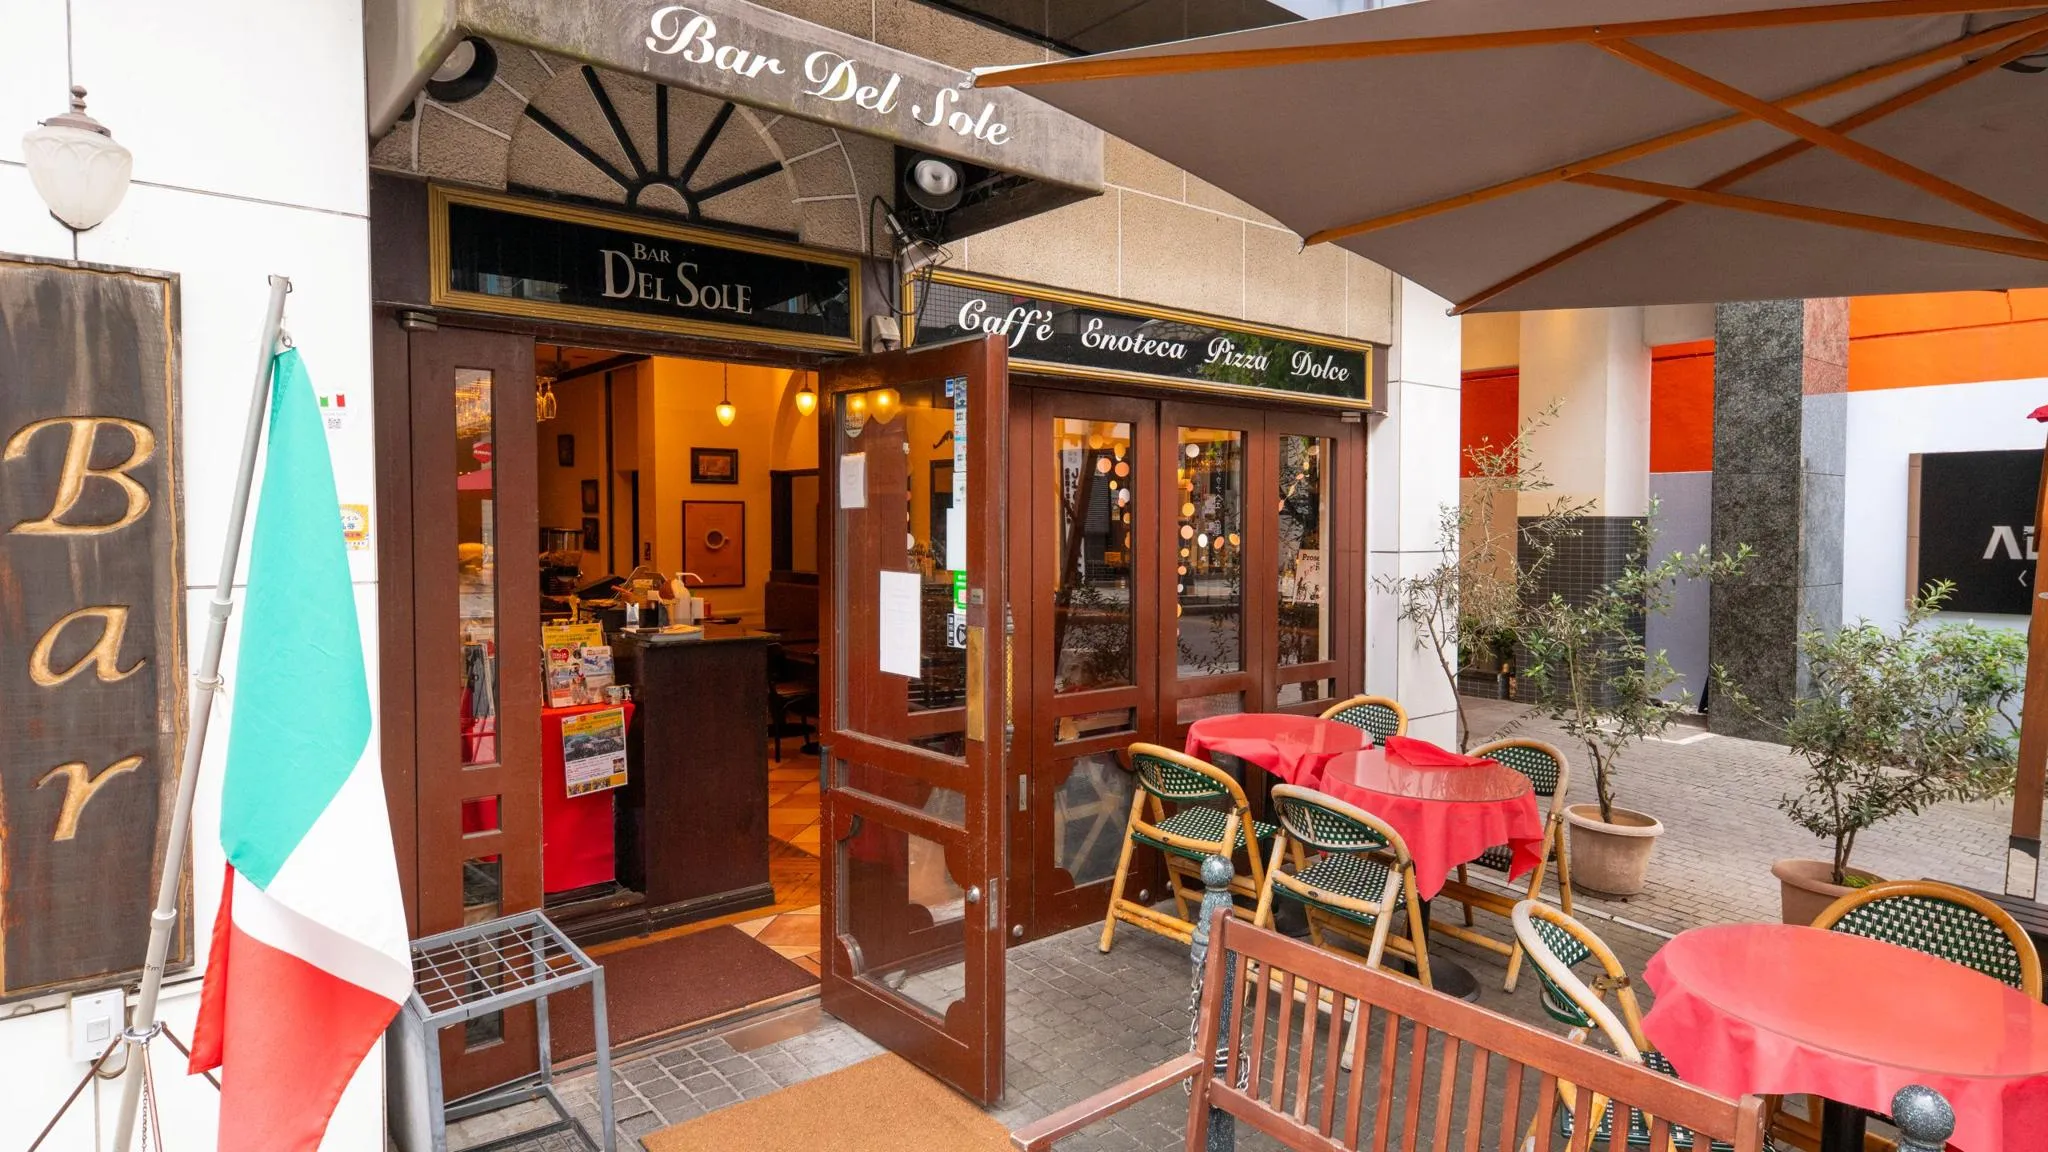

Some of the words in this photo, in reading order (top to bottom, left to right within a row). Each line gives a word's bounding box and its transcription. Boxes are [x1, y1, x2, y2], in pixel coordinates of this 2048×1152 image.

[645, 6, 786, 79] Bar
[803, 50, 902, 115] Del
[911, 88, 1014, 145] Sole
[1080, 317, 1188, 361] Enoteca
[1204, 336, 1271, 372] Pizza
[1291, 350, 1351, 383] Dolce
